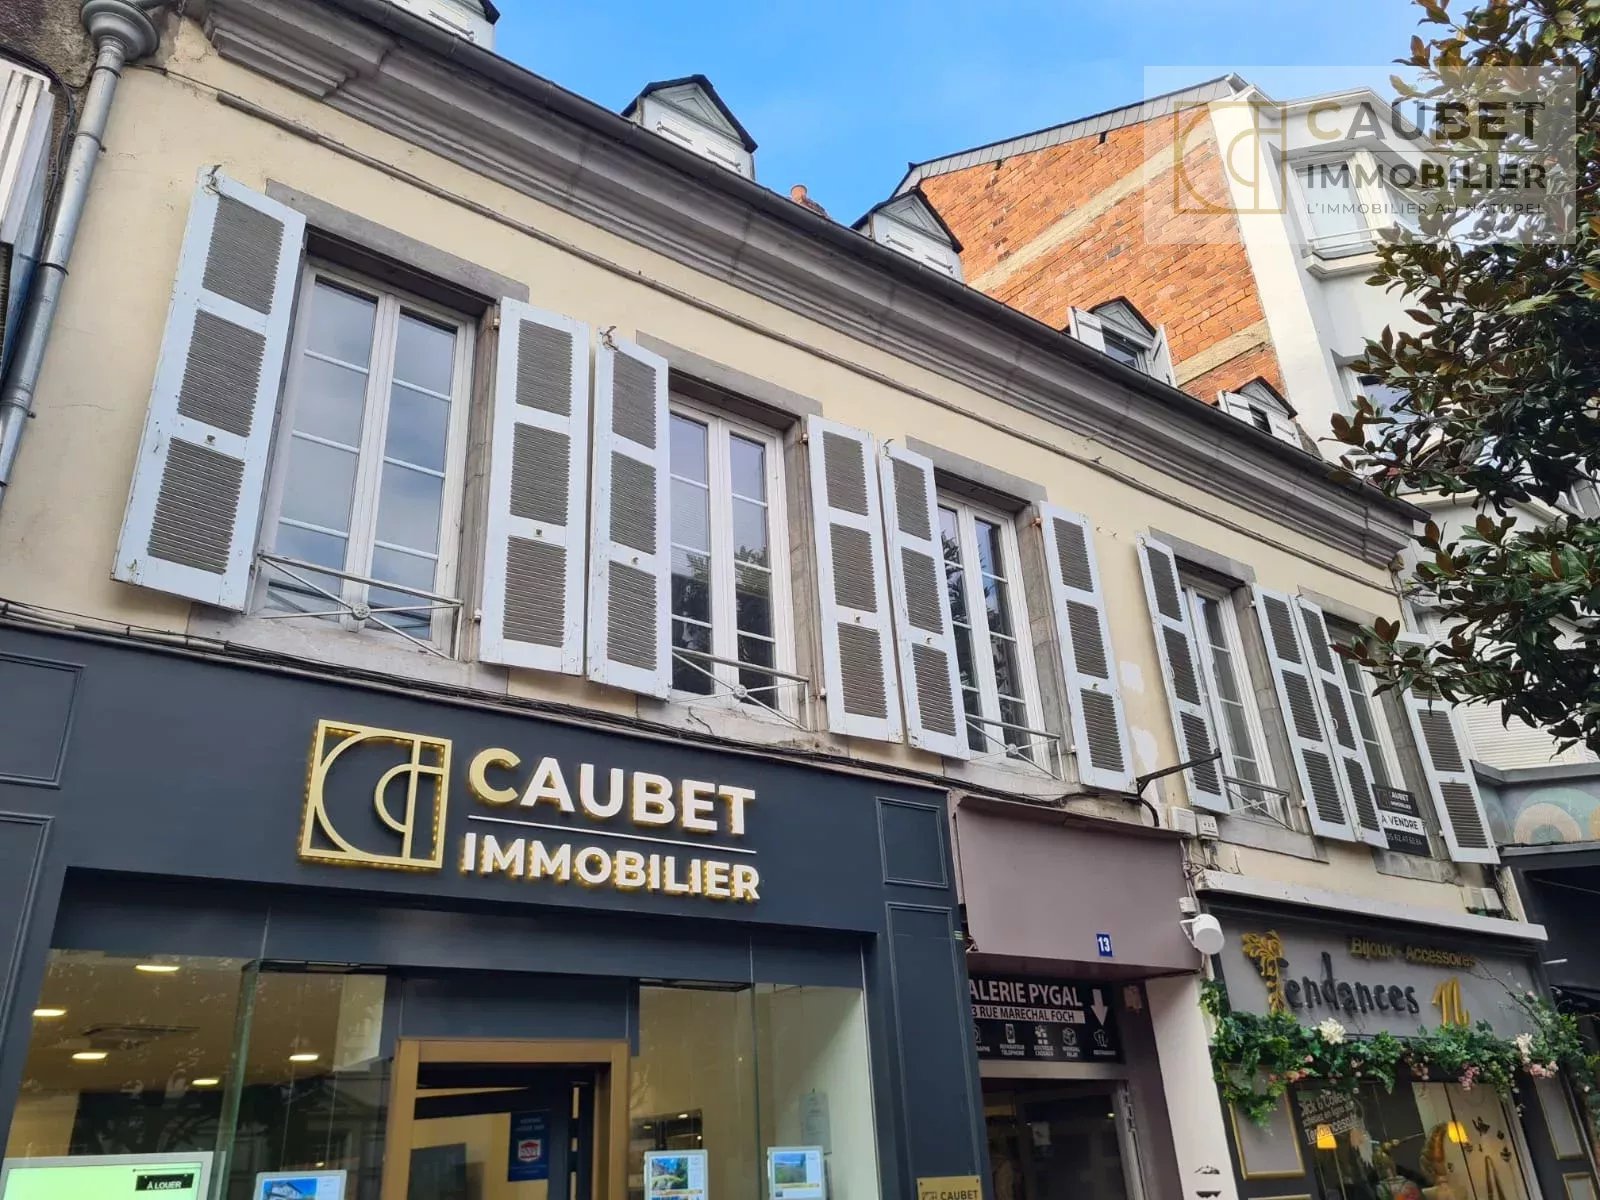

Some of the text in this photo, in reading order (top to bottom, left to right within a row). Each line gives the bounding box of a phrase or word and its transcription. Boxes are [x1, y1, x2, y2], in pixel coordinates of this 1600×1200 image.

[469, 748, 756, 834] CAUBET
[1388, 815, 1419, 830] VENDRE
[463, 832, 760, 900] IMMOBILIER
[1098, 936, 1110, 952] 13
[968, 979, 1083, 1007] ALERIE PYGAL
[980, 1007, 998, 1018] RUE
[1000, 1008, 1049, 1021] MARECHAL
[1051, 1010, 1075, 1022] FOCH
[155, 1181, 182, 1189] LOUER
[940, 1190, 979, 1200] CAUBET
